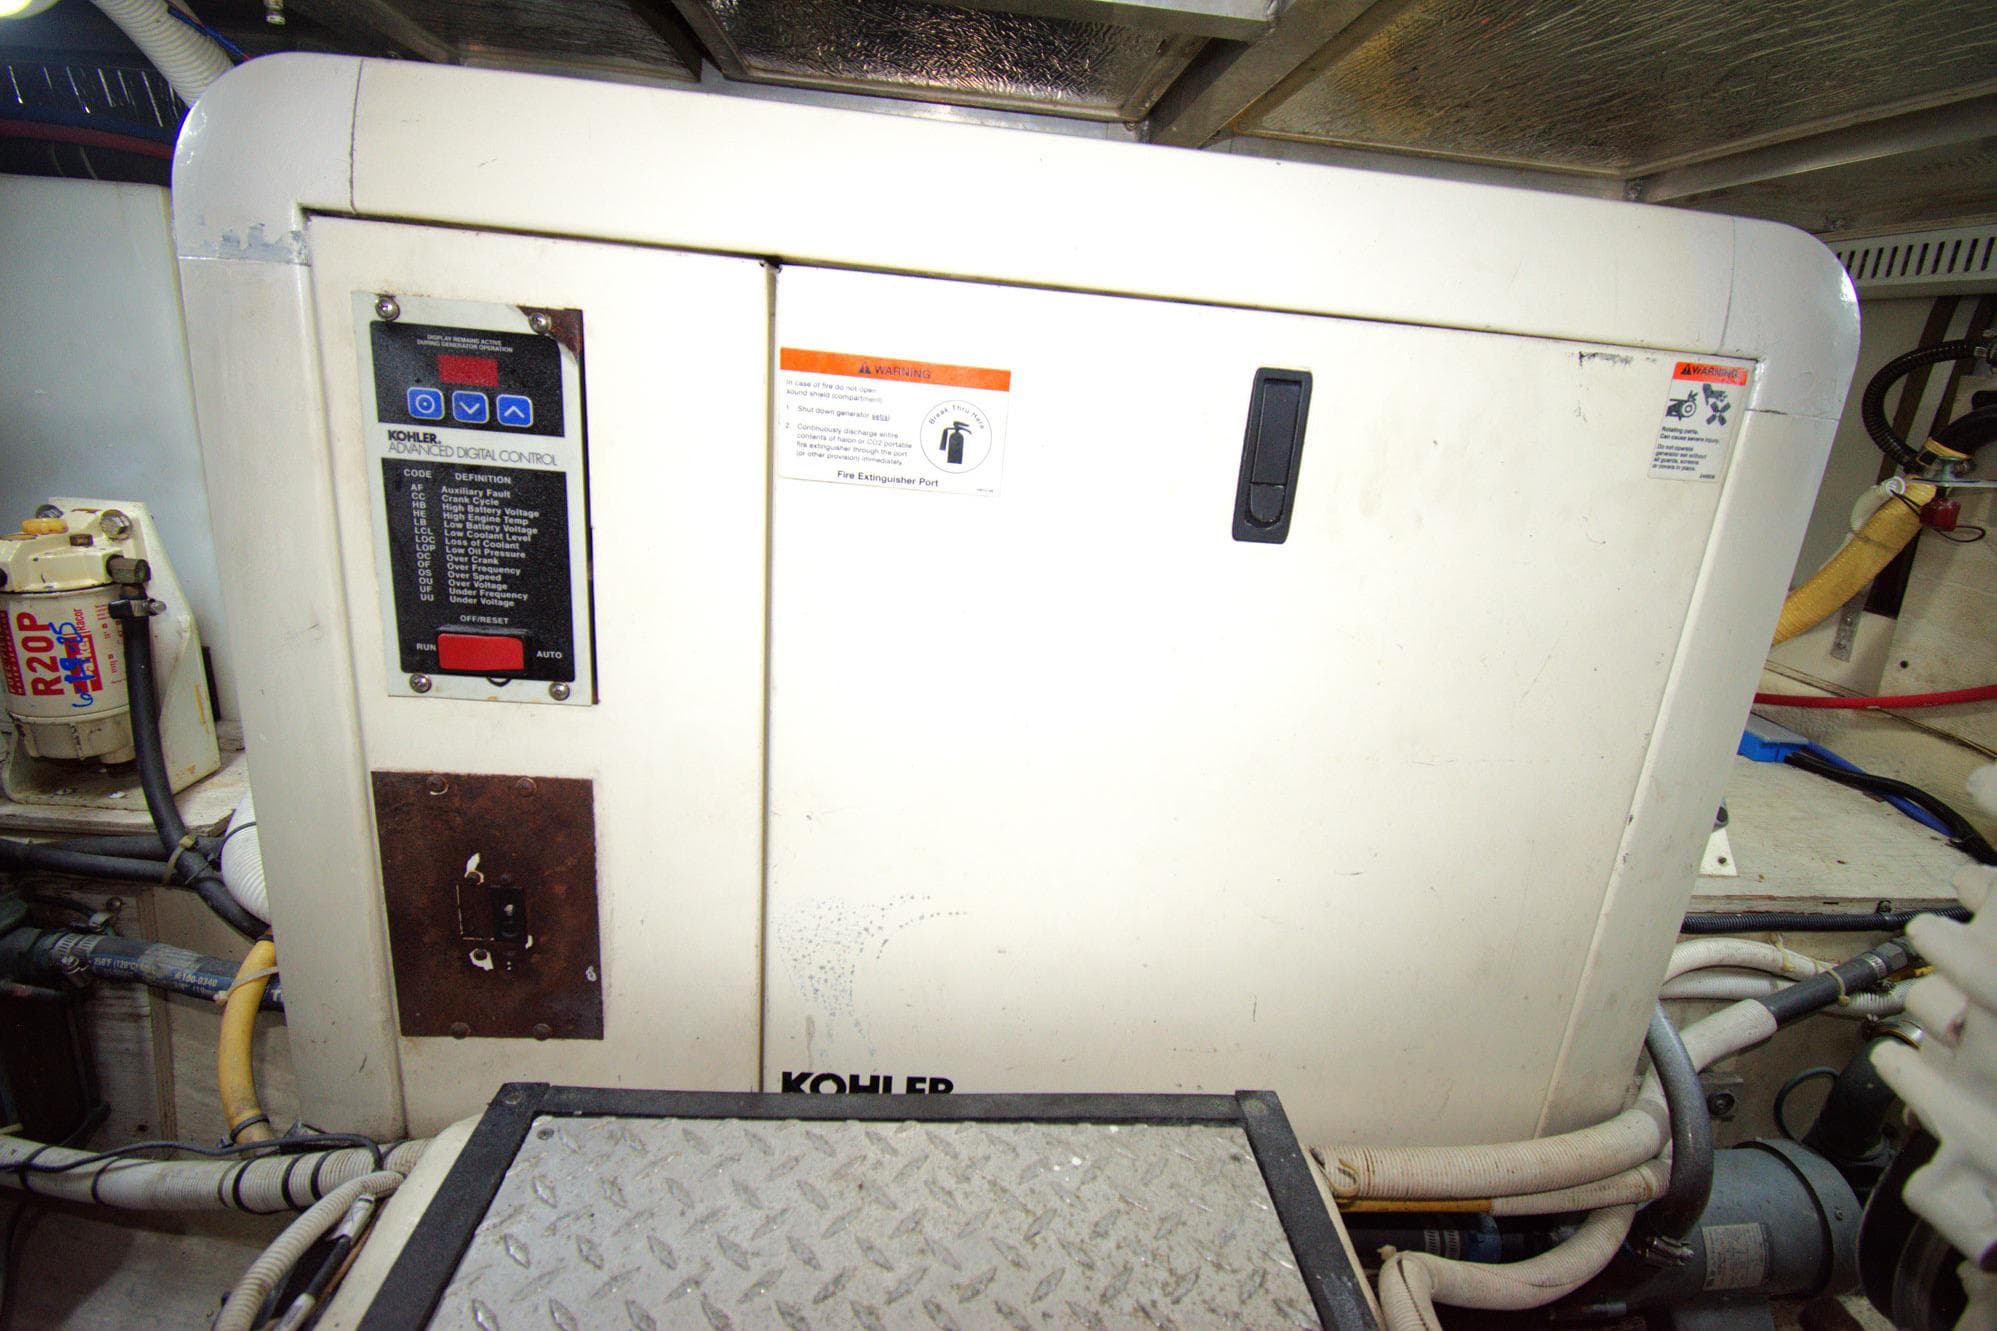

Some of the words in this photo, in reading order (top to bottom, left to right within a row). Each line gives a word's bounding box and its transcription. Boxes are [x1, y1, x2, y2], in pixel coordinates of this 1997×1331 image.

[427, 334, 451, 342] DISPLAY
[417, 339, 440, 347] DURING
[479, 344, 513, 353] OPERATION
[874, 365, 932, 379] WARNING
[1692, 365, 1738, 378] WARNING
[786, 389, 808, 397] sound
[809, 390, 830, 399] shield
[797, 405, 814, 413] Shut
[815, 407, 835, 415] down
[836, 409, 869, 418] generator
[928, 407, 948, 424] Break
[952, 404, 970, 414] Thru
[971, 412, 985, 429] Here
[797, 423, 841, 434] Continuously
[843, 427, 878, 438] discharge
[879, 431, 899, 439] entire
[796, 433, 827, 441] contents
[837, 436, 857, 444] halon
[866, 438, 882, 446] CO2
[883, 440, 912, 449] portable
[388, 443, 454, 459] ADVANCED
[456, 447, 497, 462] DIGITAL
[500, 450, 557, 466] CONTROL
[796, 440, 808, 448] fire
[809, 442, 851, 452] extinguisher
[852, 446, 879, 456] through
[893, 450, 908, 458] port
[807, 450, 825, 458] other
[403, 468, 433, 479] CODE
[454, 472, 512, 485] DEFINITION
[837, 470, 855, 479] Fire
[857, 471, 917, 485] Extinguisher
[918, 477, 939, 487] Port
[410, 483, 424, 491] AF
[441, 485, 483, 497] Auxiliary
[486, 489, 511, 498] Fault
[411, 492, 426, 500] CC
[441, 494, 470, 504] Crank
[472, 496, 499, 507] Cycle
[412, 501, 427, 509] HB
[442, 503, 465, 513] High
[467, 504, 501, 516] Battery
[504, 507, 540, 518] Voltage
[413, 509, 427, 518] HE
[443, 511, 465, 522] High
[468, 513, 501, 525] Engine
[504, 516, 529, 527] Temp
[414, 518, 427, 526] LB
[443, 520, 464, 530] Low
[466, 521, 500, 533] Battery
[503, 524, 538, 535] Voltage
[414, 526, 433, 535] LCL
[444, 528, 464, 538] Low
[466, 530, 503, 541] Coolant
[506, 532, 532, 542] Level
[415, 535, 436, 544] LOC
[445, 537, 468, 546] Loss
[471, 538, 480, 547] of
[482, 539, 520, 550] Coolant
[416, 543, 436, 552] LOP
[445, 545, 465, 554] Low
[467, 546, 482, 556] Oil
[484, 547, 526, 559] Pressure
[416, 552, 432, 560] OC
[446, 554, 469, 563] Over
[471, 555, 499, 565] Crank
[417, 560, 431, 568] OF
[447, 562, 470, 571] Over
[471, 564, 521, 577] Frequency
[418, 568, 432, 577] OS
[447, 570, 470, 579] Over
[472, 572, 502, 582] Speed
[419, 577, 433, 585] OU
[448, 579, 471, 588] Over
[473, 580, 508, 591] Voltage
[419, 585, 432, 593] UF
[449, 587, 477, 597] Under
[479, 588, 528, 601] Frequency
[420, 593, 434, 601] UU
[450, 596, 477, 605] Under
[479, 596, 515, 608] Voltage
[73, 608, 86, 631] Racor
[460, 615, 509, 625] OFF/RESET
[16, 612, 65, 696] R20P
[416, 642, 437, 651] RUN
[536, 651, 562, 660] AUTO
